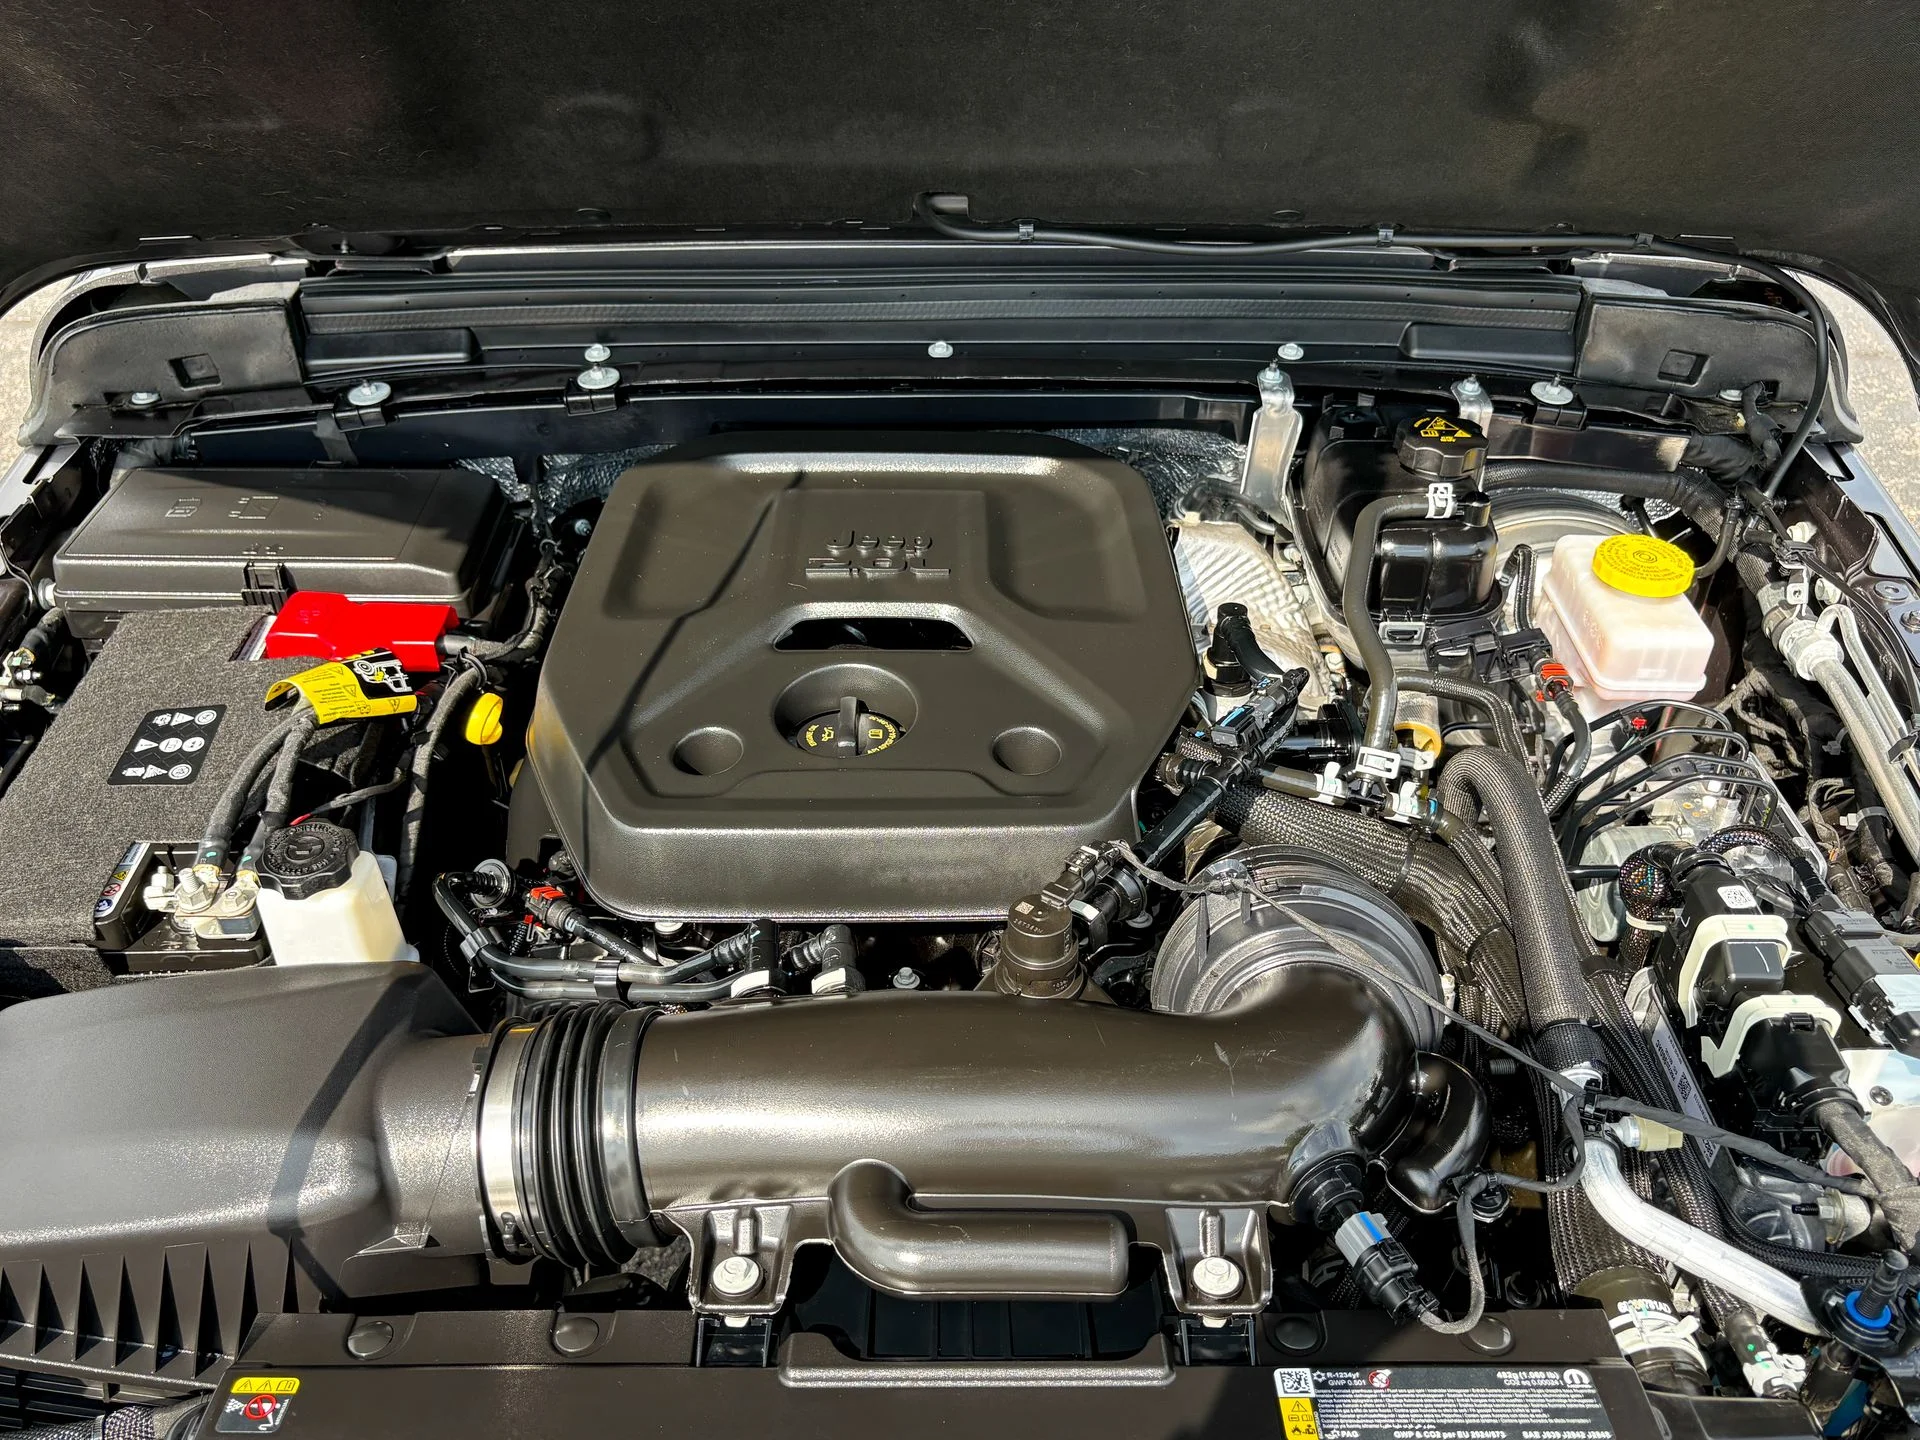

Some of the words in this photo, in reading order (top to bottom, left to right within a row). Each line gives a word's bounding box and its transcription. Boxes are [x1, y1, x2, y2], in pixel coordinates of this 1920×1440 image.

[826, 530, 933, 558] Jeep
[805, 557, 951, 577] 2.0L
[1326, 1371, 1360, 1379] R-1234yf
[1393, 1430, 1414, 1438] GWP
[1423, 1430, 1441, 1438] CO2
[1442, 1432, 1456, 1440] per
